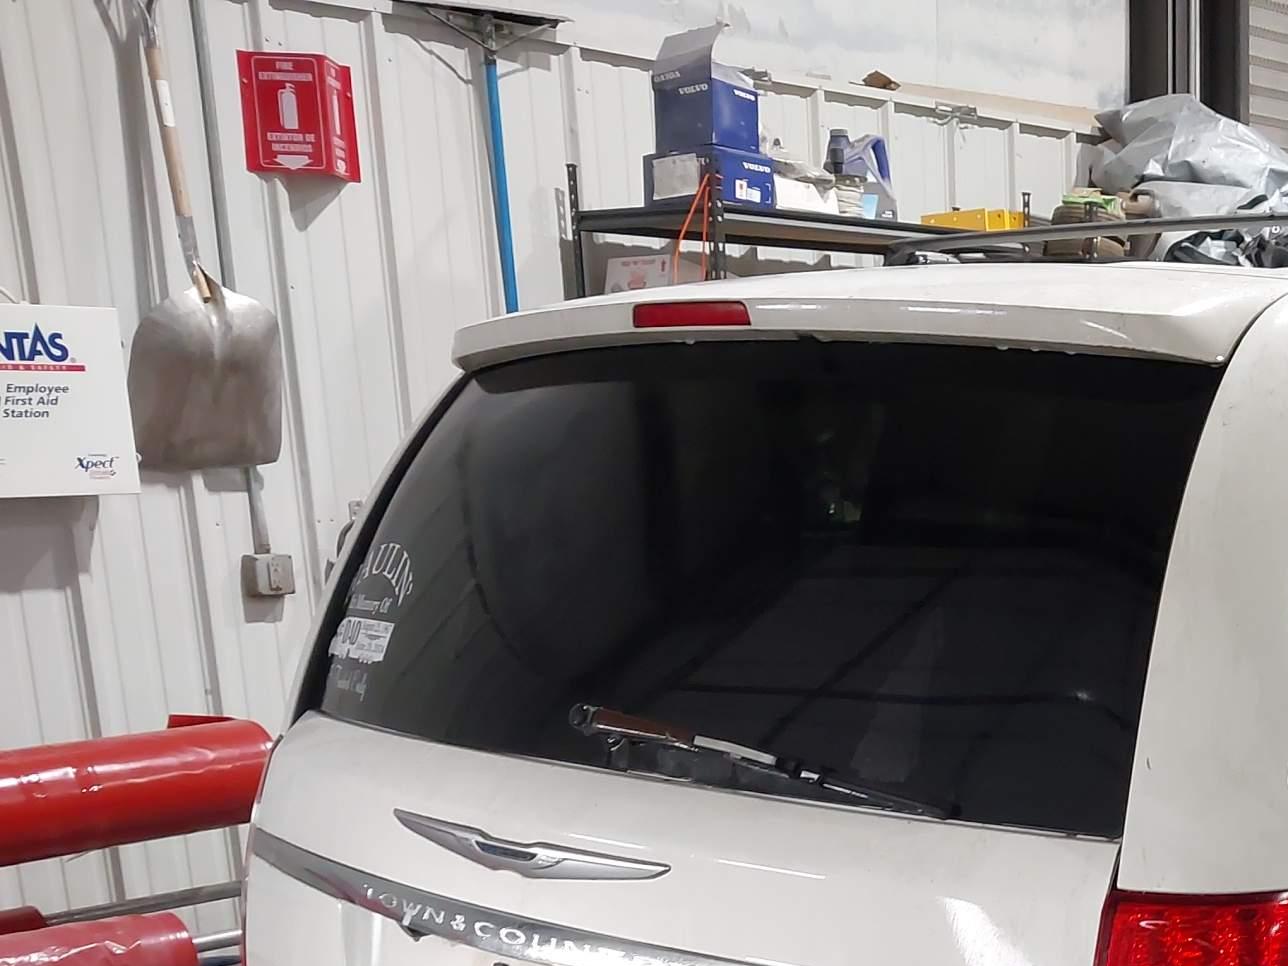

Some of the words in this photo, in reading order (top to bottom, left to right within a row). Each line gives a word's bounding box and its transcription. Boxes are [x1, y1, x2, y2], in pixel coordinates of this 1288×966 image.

[678, 83, 709, 95] VOLVO
[742, 161, 772, 174] VOLVO
[0, 323, 69, 362] NTAS
[5, 383, 70, 396] Employee
[4, 395, 33, 406] First
[36, 395, 59, 406] Aid
[2, 407, 50, 418] Station
[75, 456, 115, 472] Xpect
